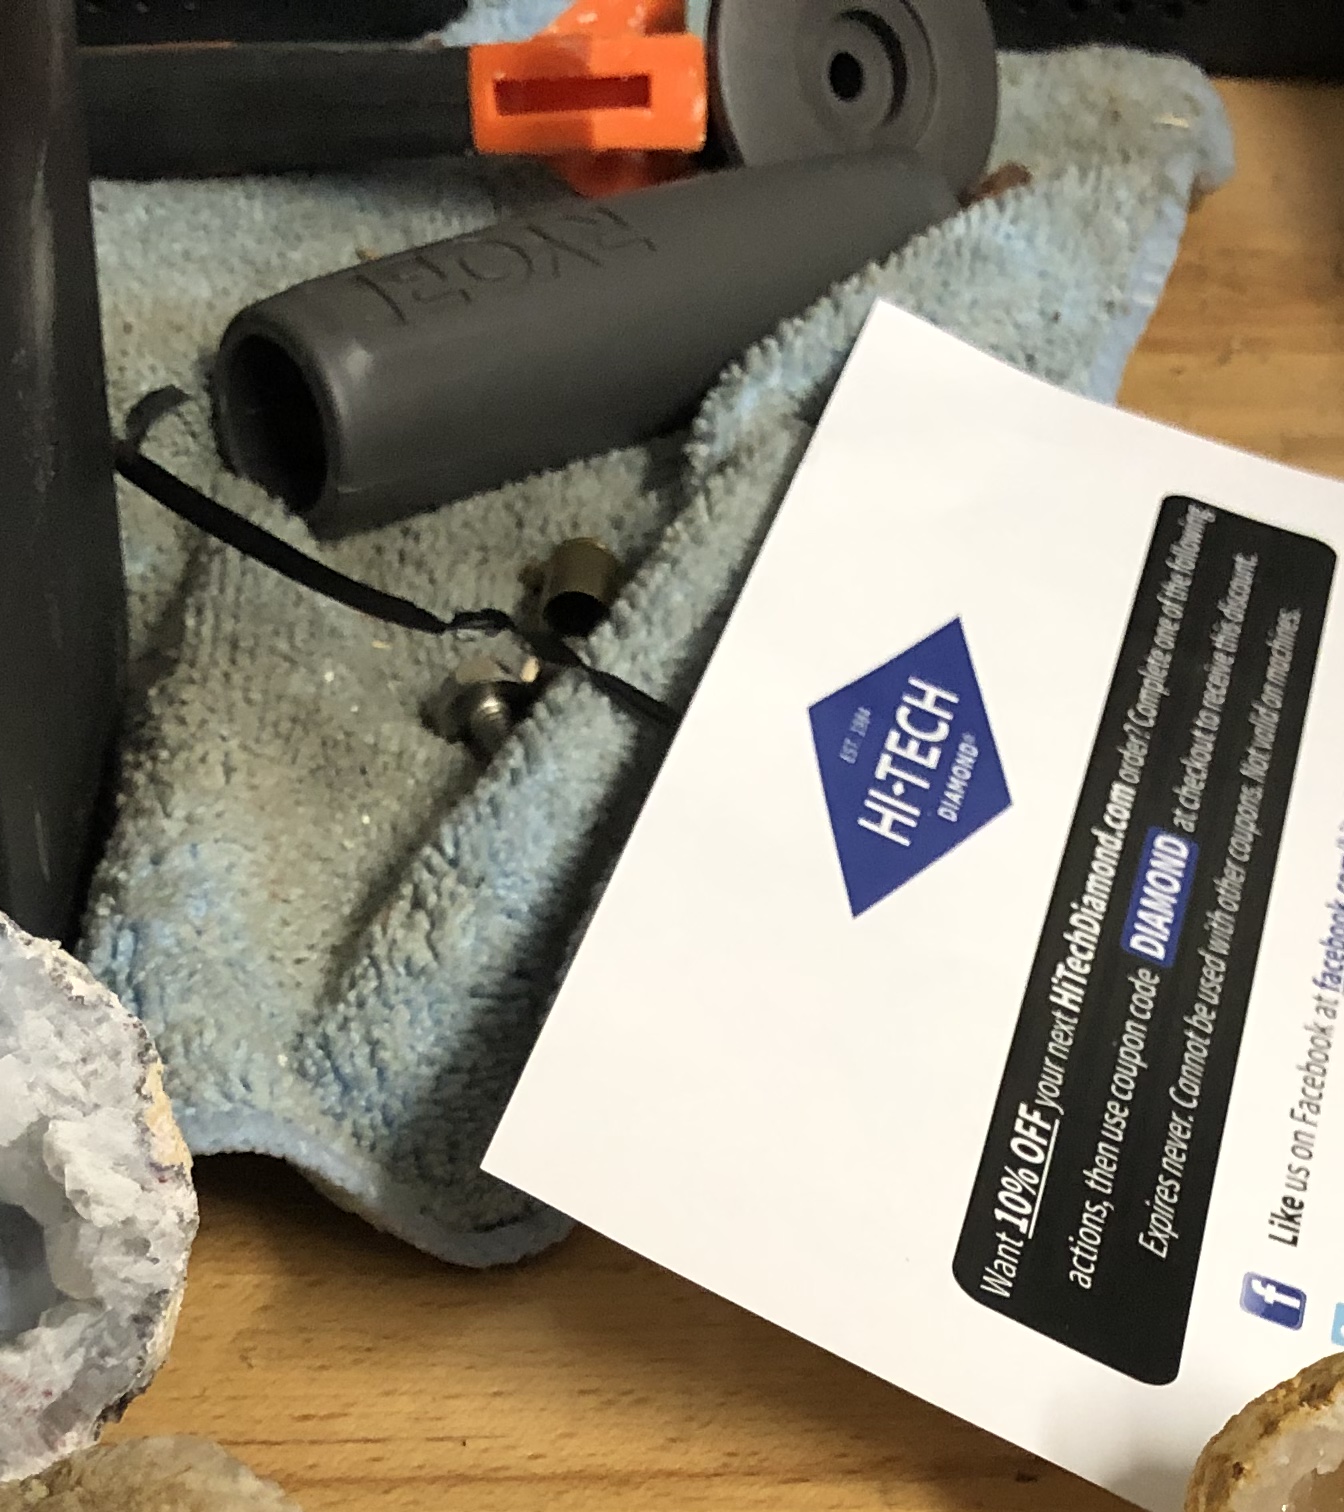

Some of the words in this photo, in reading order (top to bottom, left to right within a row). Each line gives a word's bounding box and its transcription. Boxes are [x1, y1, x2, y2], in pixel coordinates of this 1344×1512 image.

[1166, 502, 1215, 576] following
[1157, 595, 1187, 619] of
[1161, 571, 1192, 602] the
[1154, 617, 1180, 651] one
[1125, 648, 1172, 730] Complete
[1201, 650, 1234, 711] receive
[1260, 682, 1284, 708] on
[1195, 708, 1222, 731] to
[1247, 699, 1281, 750] valid
[1117, 723, 1152, 784] order?
[1173, 726, 1217, 810] checkout
[1239, 744, 1269, 783] Not
[1172, 806, 1199, 833] at
[1226, 782, 1264, 863] coupons.
[1048, 780, 1138, 1011] HiTechDiamond.com
[1130, 833, 1189, 960] DIAMOND
[1212, 856, 1248, 912] other
[1203, 906, 1235, 954] with
[1127, 966, 1160, 1020] code
[1197, 948, 1227, 1005] used
[1046, 1007, 1079, 1060] next
[1184, 1000, 1216, 1033] be
[1310, 994, 1338, 1020] at
[1034, 1056, 1065, 1115] your
[1110, 1019, 1148, 1102] coupon
[1169, 1029, 1211, 1109] Cannot
[1289, 1020, 1334, 1127] Facebook
[1010, 1102, 1052, 1165] OFF
[1100, 1099, 1130, 1141] use
[1161, 1111, 1195, 1177] never.
[1289, 1128, 1315, 1160] on
[1083, 1139, 1121, 1194] then
[1285, 1162, 1310, 1192] us
[994, 1166, 1040, 1233] 10%
[1138, 1173, 1179, 1259] Expires
[1267, 1194, 1304, 1247] Like
[980, 1229, 1025, 1298] Want
[1067, 1196, 1115, 1290] actions,
